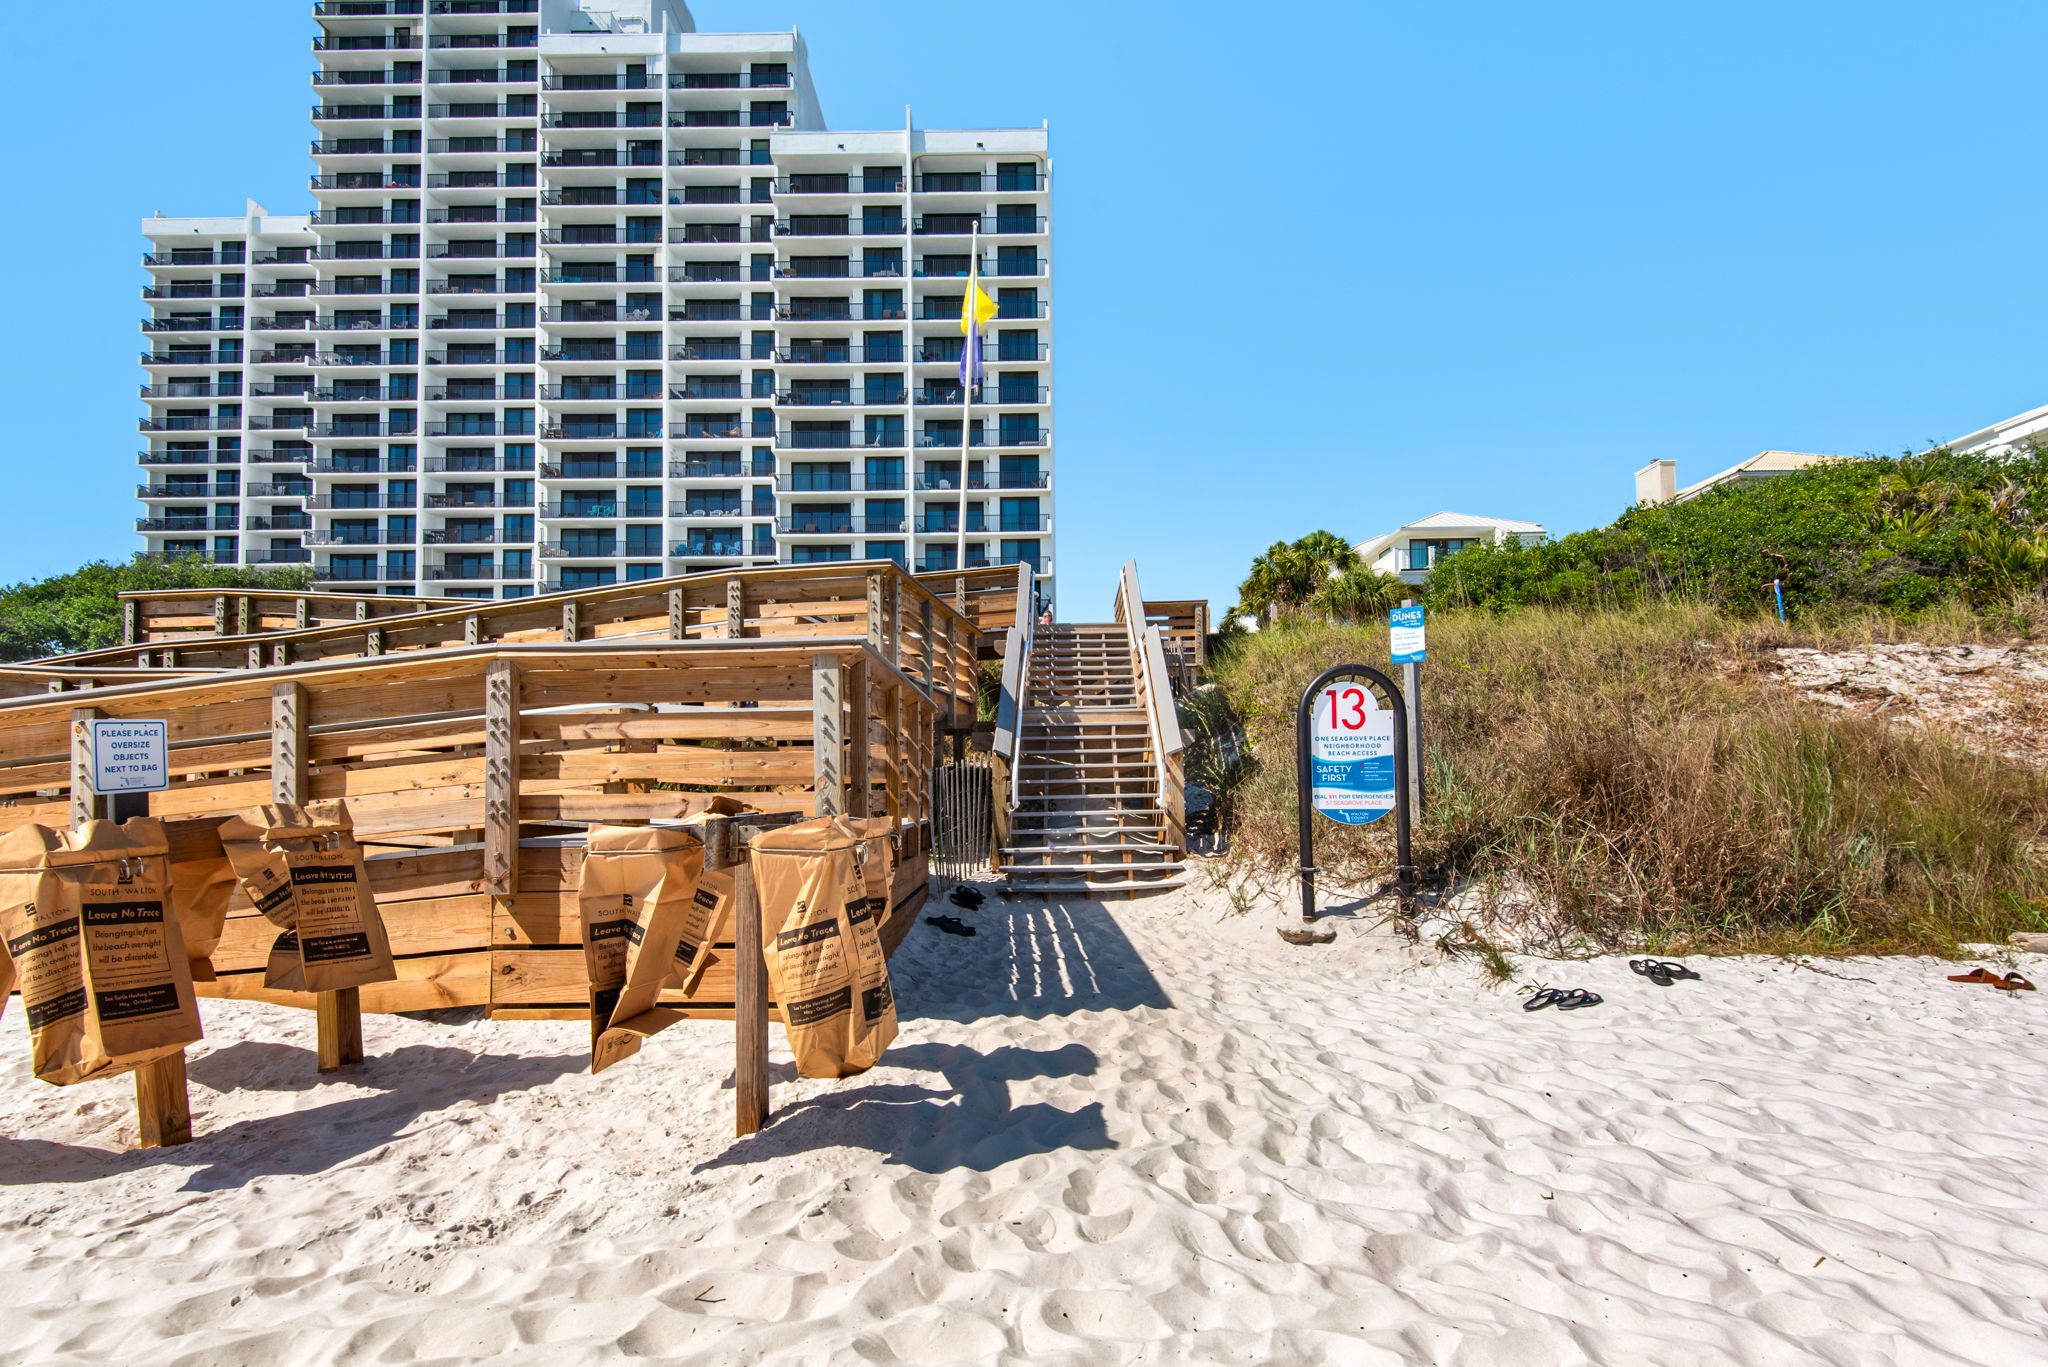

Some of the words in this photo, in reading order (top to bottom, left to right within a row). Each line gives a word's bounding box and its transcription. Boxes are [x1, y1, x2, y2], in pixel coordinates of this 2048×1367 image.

[1392, 611, 1421, 622] DUNES
[1326, 688, 1366, 730] 13
[90, 888, 119, 896] SOUTH
[88, 910, 118, 920] Leave
[121, 909, 135, 918] No
[137, 908, 160, 917] Trace
[598, 908, 624, 916] SOUTH
[32, 934, 47, 944] No
[49, 925, 78, 938] Trace
[95, 929, 136, 939] Belongings
[595, 927, 621, 936] Leave
[798, 932, 808, 941] No
[811, 926, 834, 937] Trace
[104, 942, 130, 951] beach
